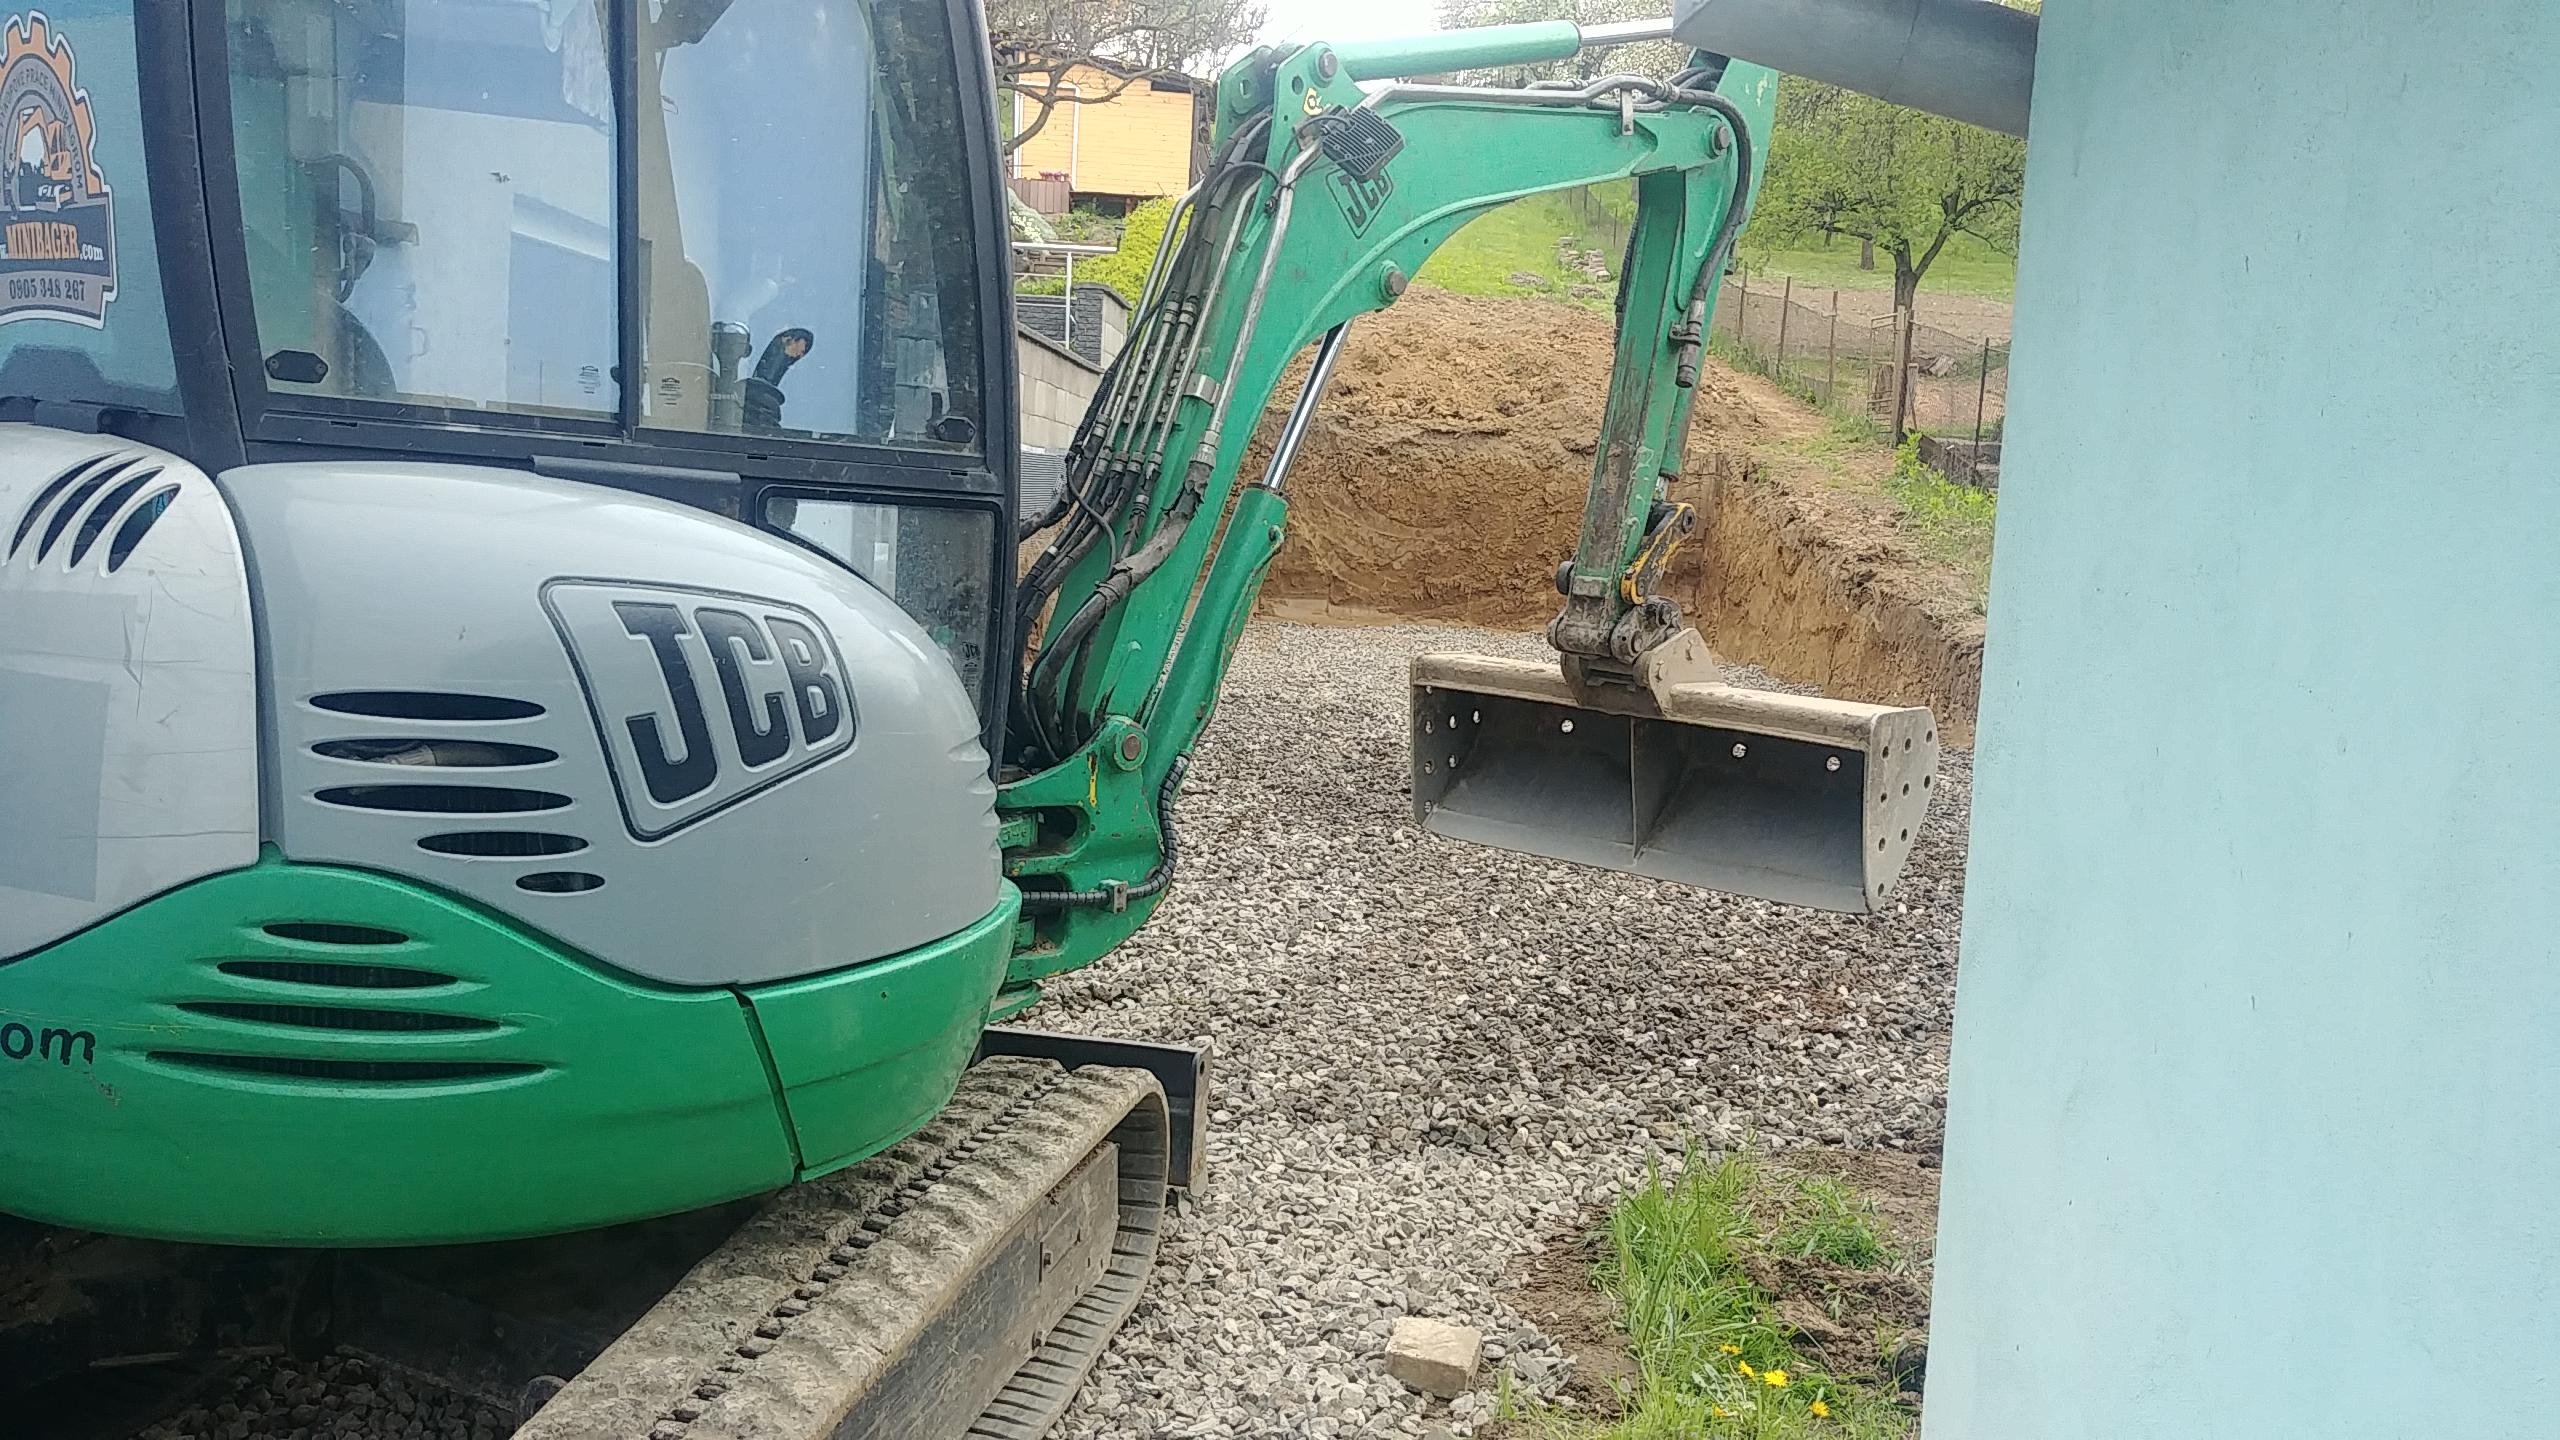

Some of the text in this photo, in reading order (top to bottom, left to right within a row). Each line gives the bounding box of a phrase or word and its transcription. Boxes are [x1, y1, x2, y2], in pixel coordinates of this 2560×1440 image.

[9, 278, 86, 301] 0905 348 267
[611, 600, 842, 805] JCB
